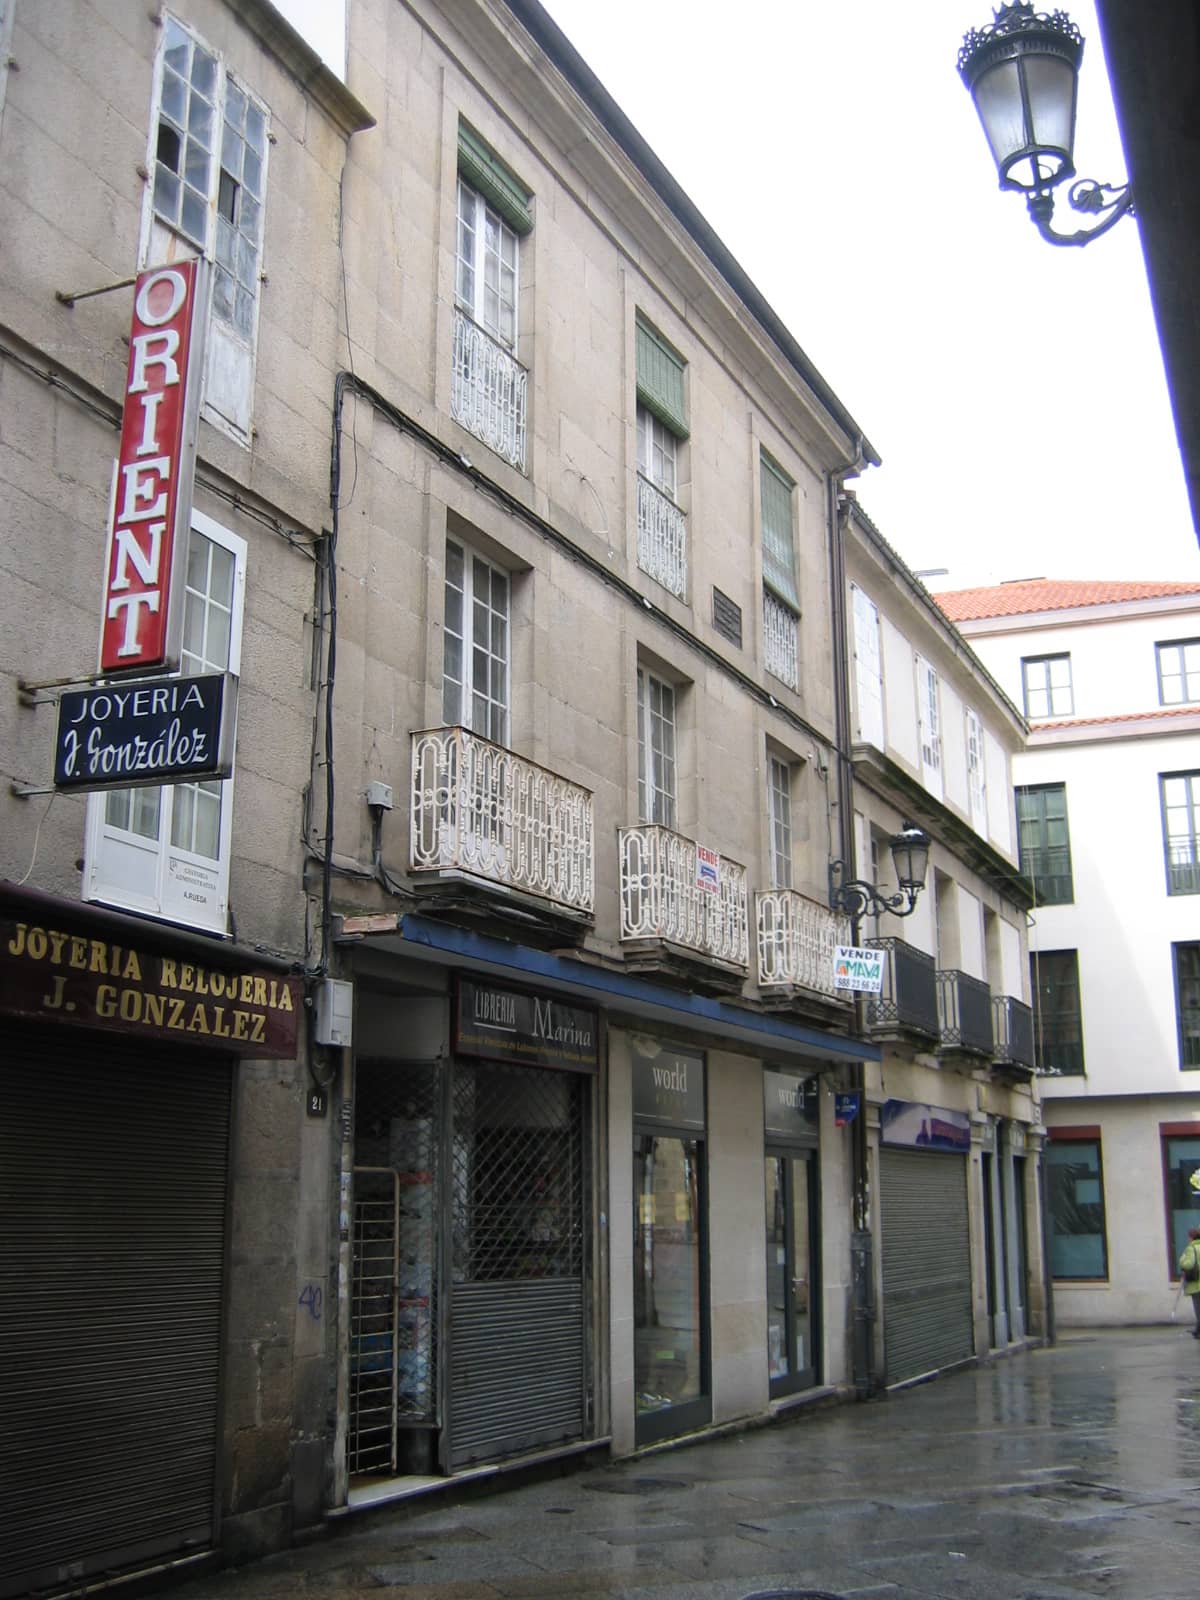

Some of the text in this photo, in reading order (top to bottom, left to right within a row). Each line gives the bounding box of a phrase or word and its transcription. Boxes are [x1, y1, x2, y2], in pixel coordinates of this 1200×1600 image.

[107, 270, 187, 658] ORIENT
[71, 684, 205, 723] JOYERIA
[64, 718, 208, 777] J. González
[8, 923, 294, 1012] JOYERIA RELOJERIA
[840, 948, 881, 961] VENDE
[43, 976, 267, 1043] J. GONZALEZ
[475, 991, 516, 1025] LIBRERIA
[531, 996, 591, 1047] Marina
[652, 1062, 688, 1093] world
[778, 1082, 805, 1109] world
[311, 1095, 322, 1111] 21
